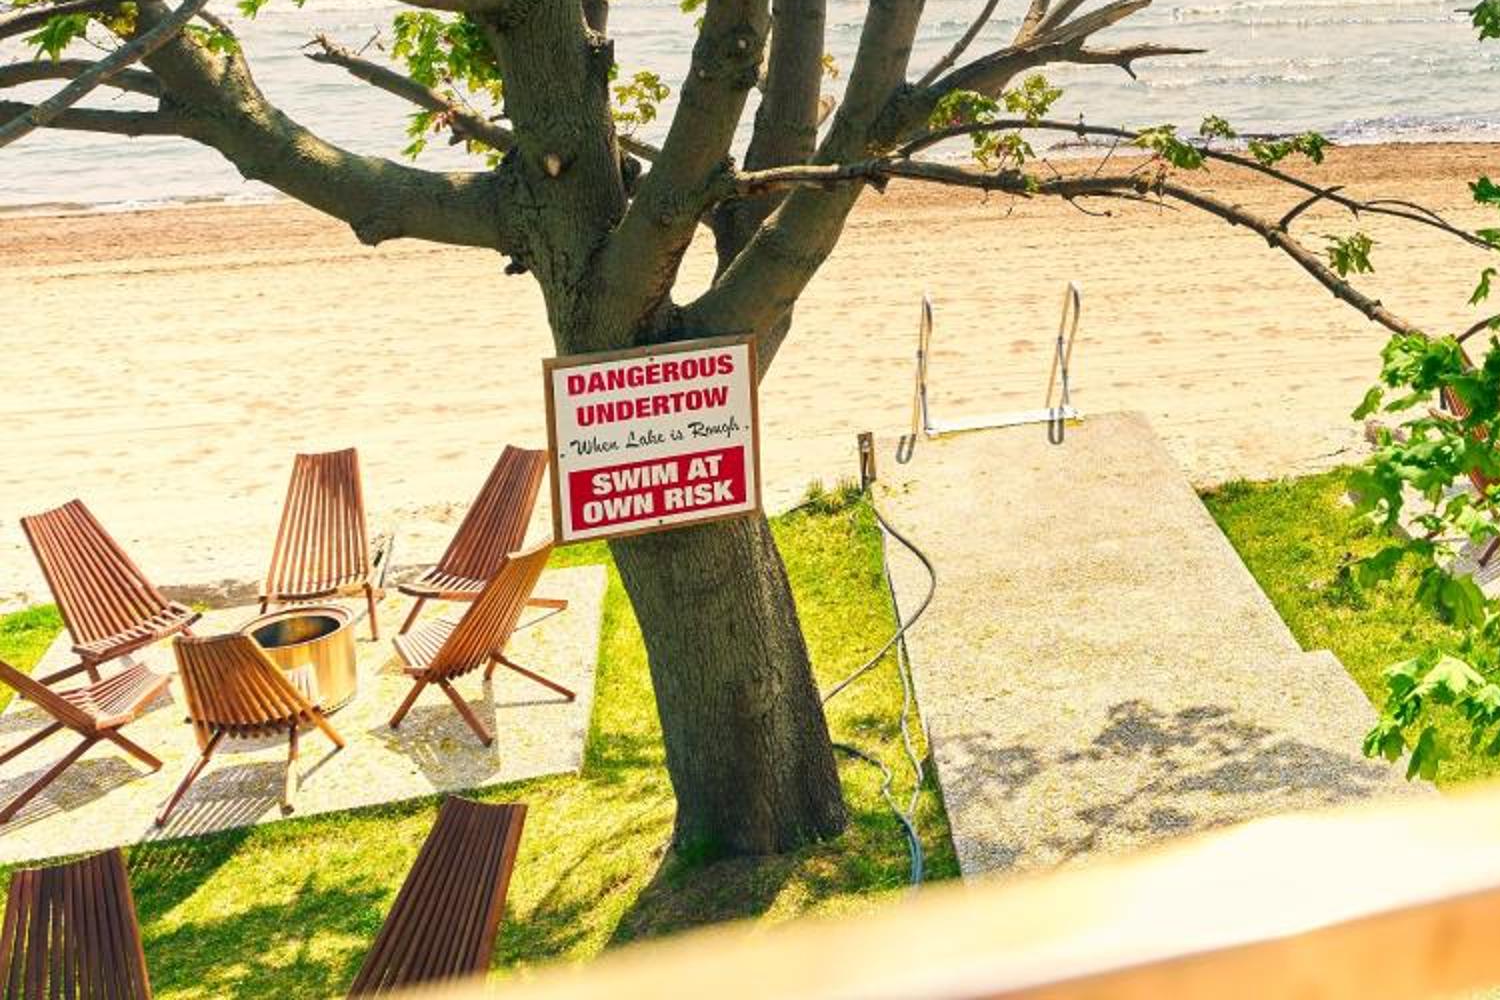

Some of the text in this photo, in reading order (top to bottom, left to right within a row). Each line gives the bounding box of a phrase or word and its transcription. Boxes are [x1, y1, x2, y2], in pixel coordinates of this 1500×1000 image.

[567, 354, 734, 396] DANGEROUS
[577, 386, 729, 427] UNDERTOW
[570, 416, 740, 456] When Lake is Rough
[591, 455, 724, 495] SWIM AT
[582, 480, 735, 524] OWN RISK
